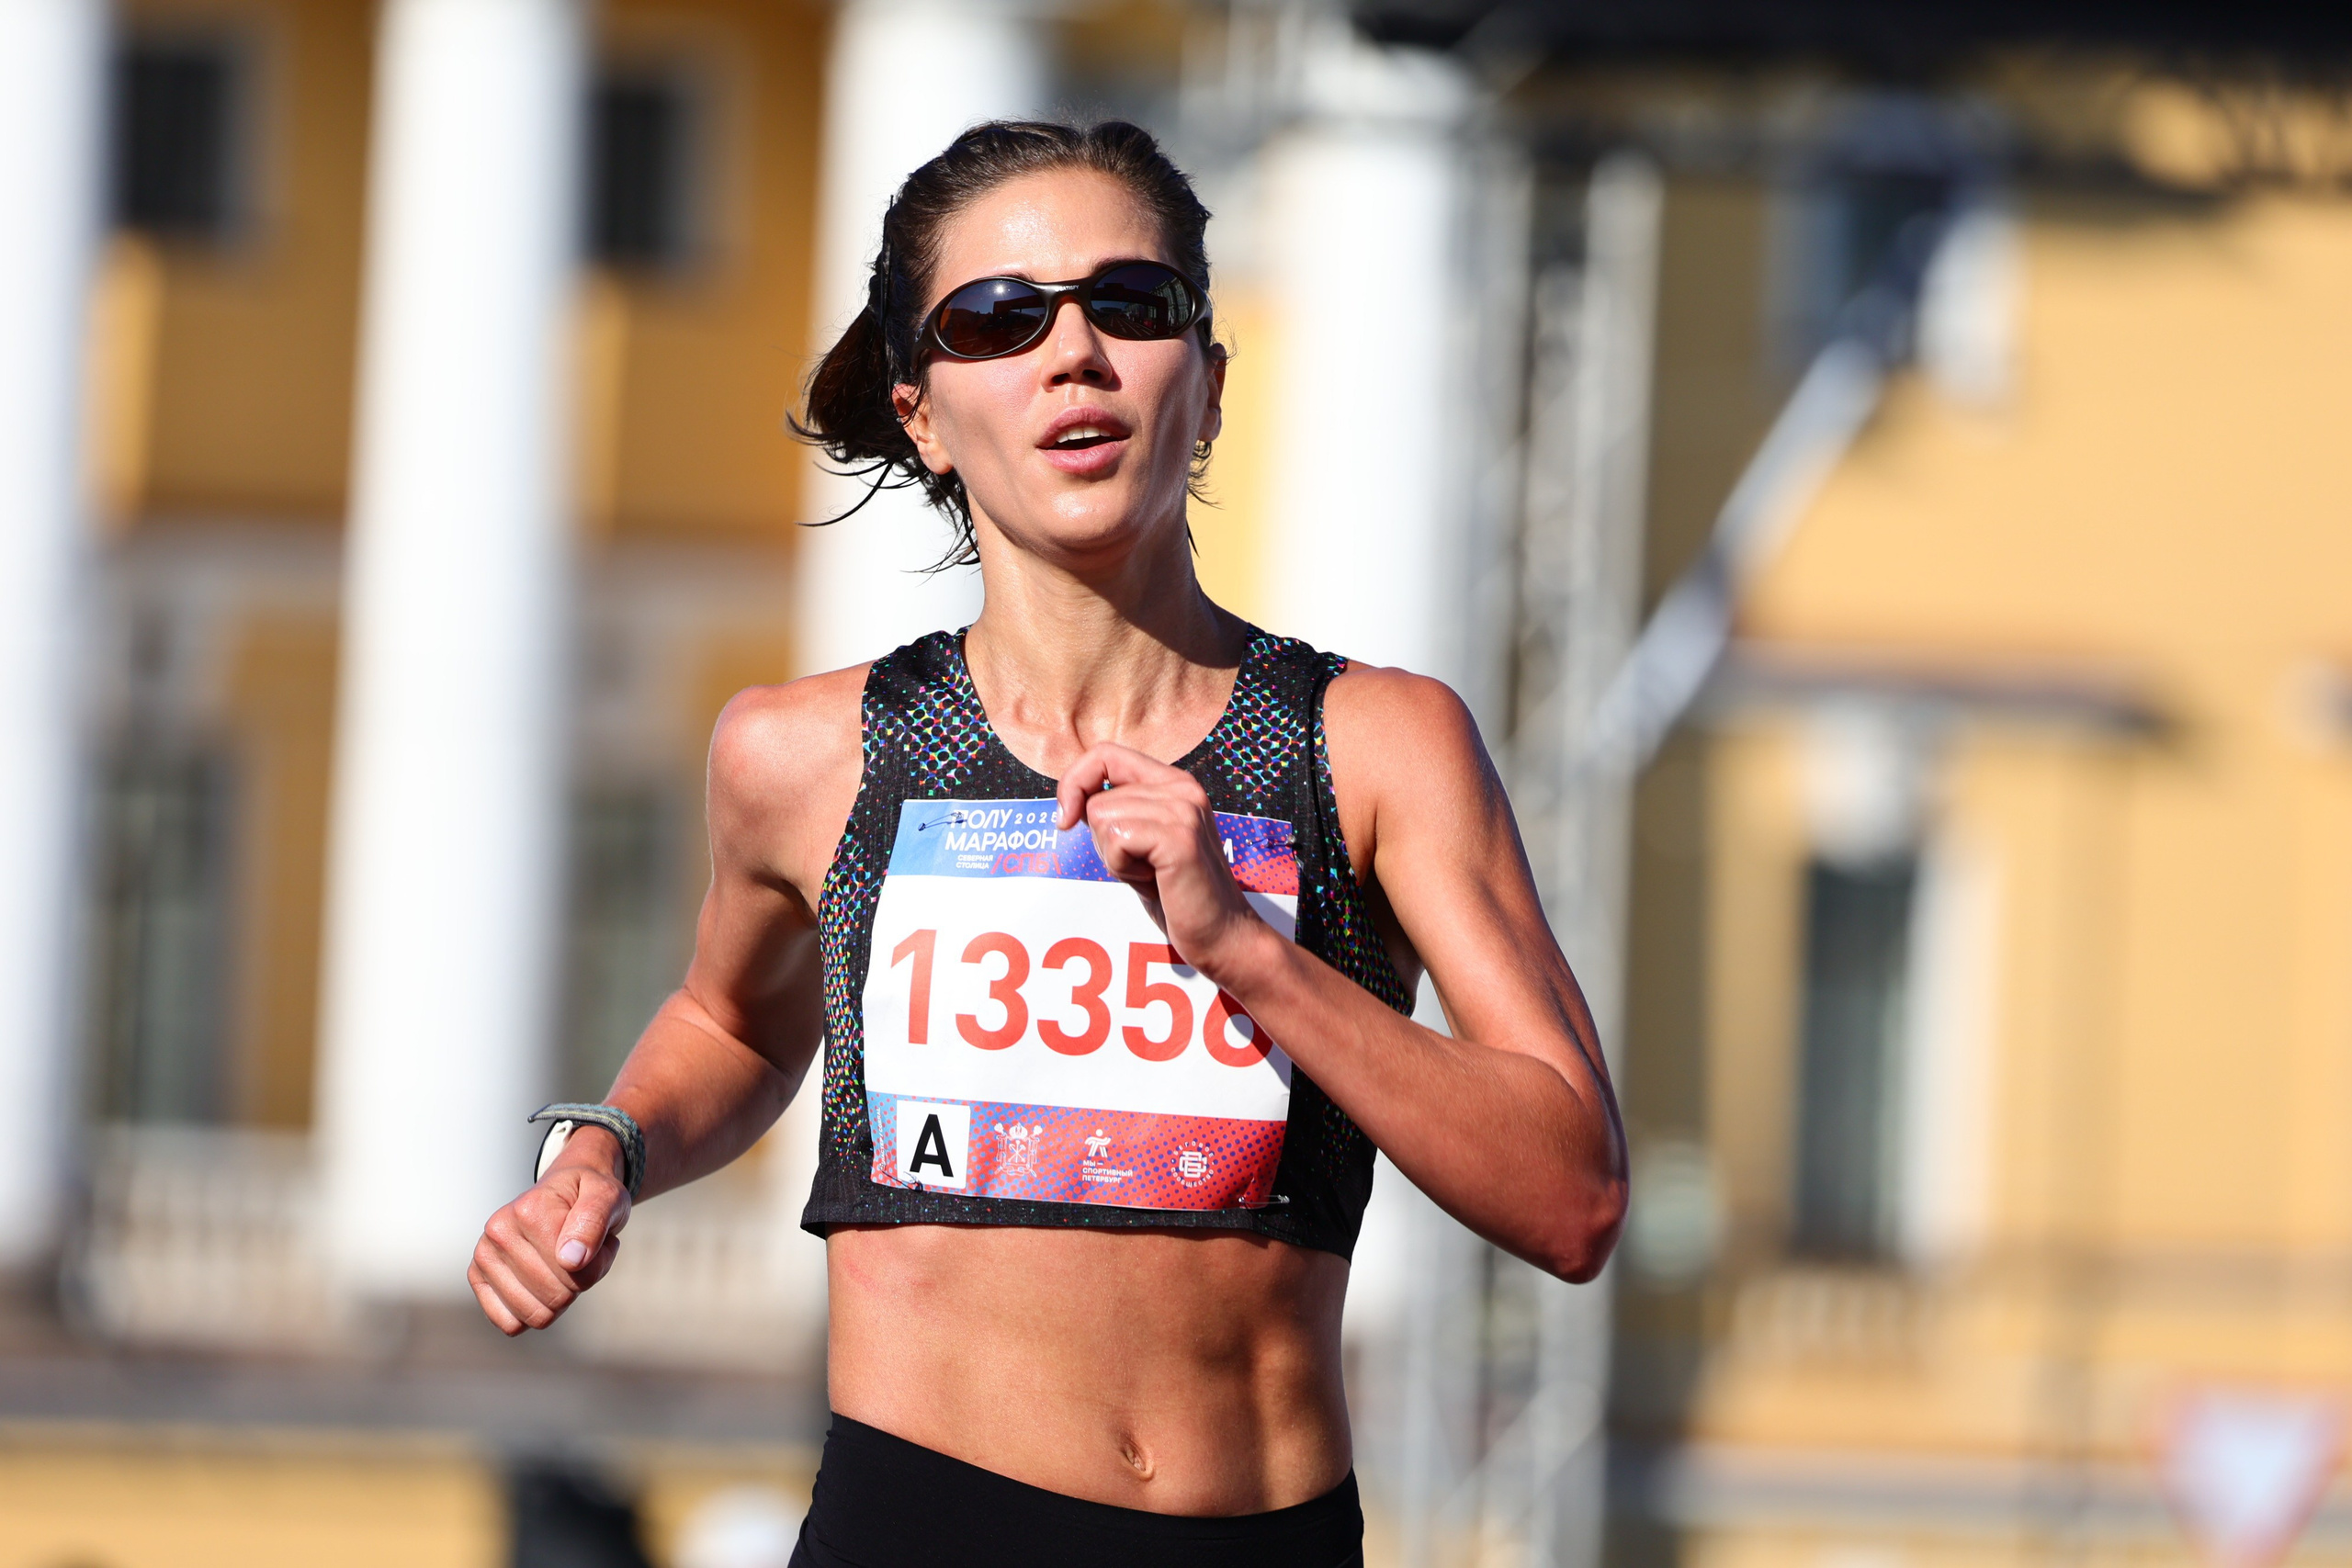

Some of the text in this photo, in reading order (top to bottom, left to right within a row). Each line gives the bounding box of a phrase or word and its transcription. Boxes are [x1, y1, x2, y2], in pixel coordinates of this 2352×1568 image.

[950, 808, 1013, 829] ПОЛУ
[944, 829, 1057, 852] МАРАФОН
[957, 853, 994, 862] СЕВЕРНАЯ
[956, 861, 989, 869] СТОЛИЦА
[1173, 1141, 1214, 1157] БЕГОВОЕ
[1082, 1168, 1133, 1177] СПОРТИВНЫЙ
[1170, 1167, 1214, 1188] СООБЩЕСТВО
[1082, 1175, 1122, 1183] ПЕТЕРБУРГ
